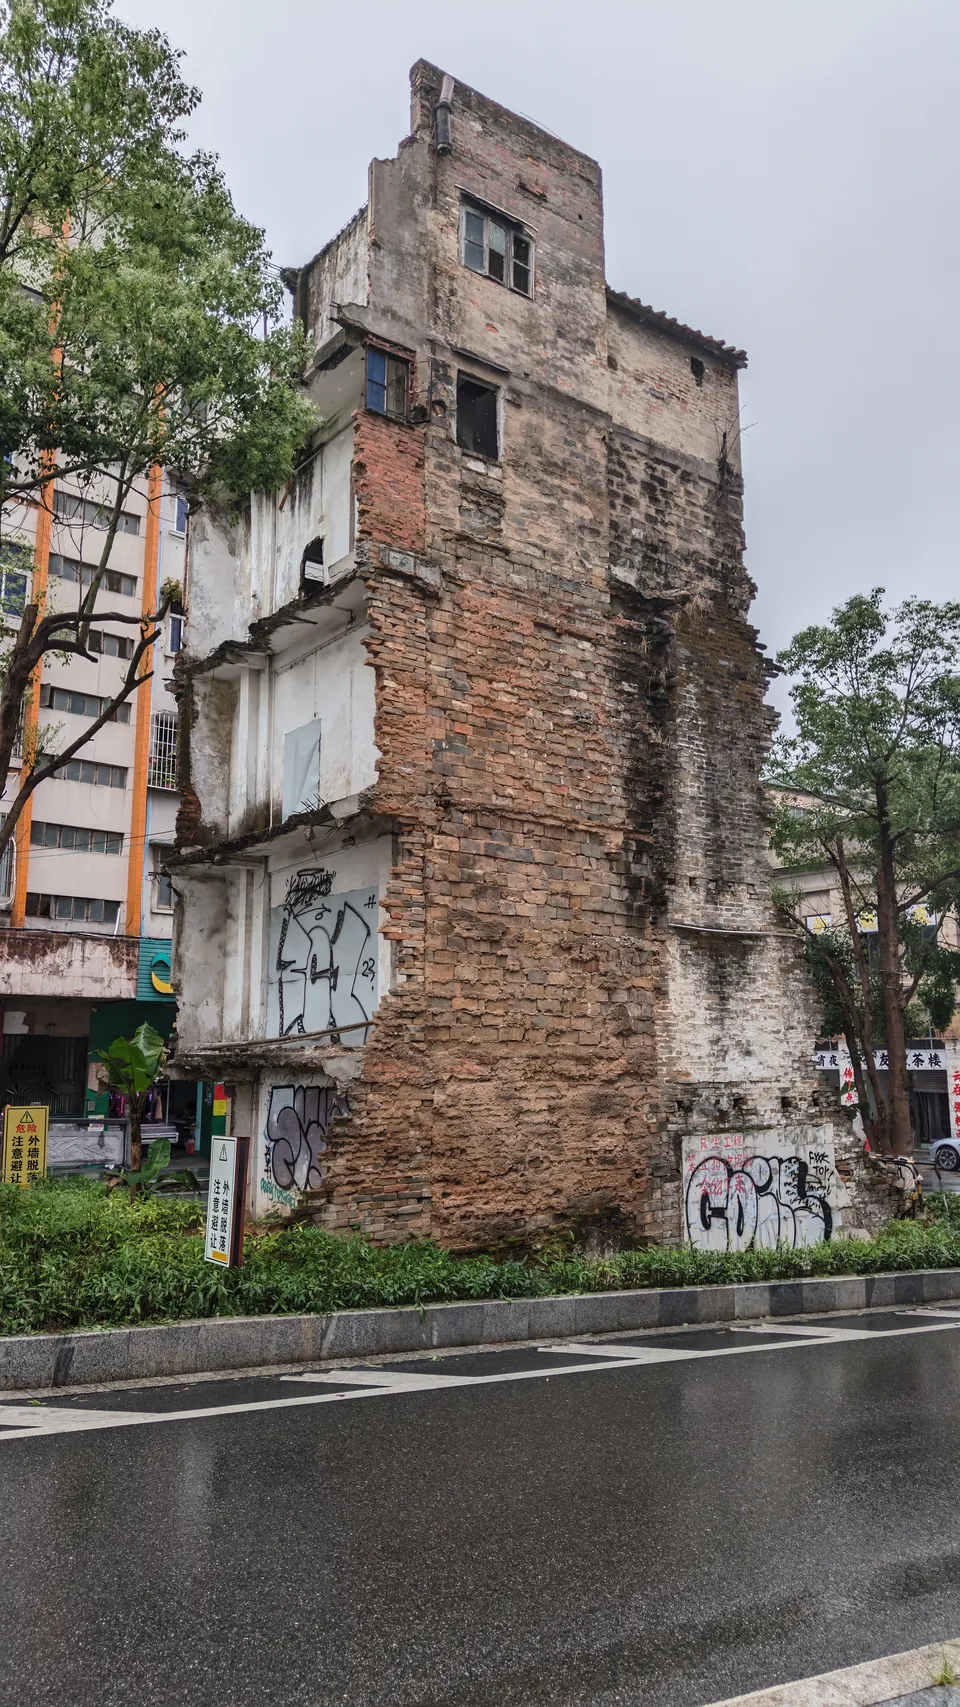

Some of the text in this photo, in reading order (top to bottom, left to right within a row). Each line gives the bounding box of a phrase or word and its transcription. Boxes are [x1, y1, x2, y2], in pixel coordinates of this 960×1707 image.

[16, 1124, 37, 1133] 危险
[700, 1135, 743, 1149] 民生工程
[10, 1136, 23, 1183] 注意避让
[27, 1135, 40, 1182] 外墙脱落
[210, 1179, 221, 1249] 注意避让
[219, 1180, 230, 1251] 外墙脱落
